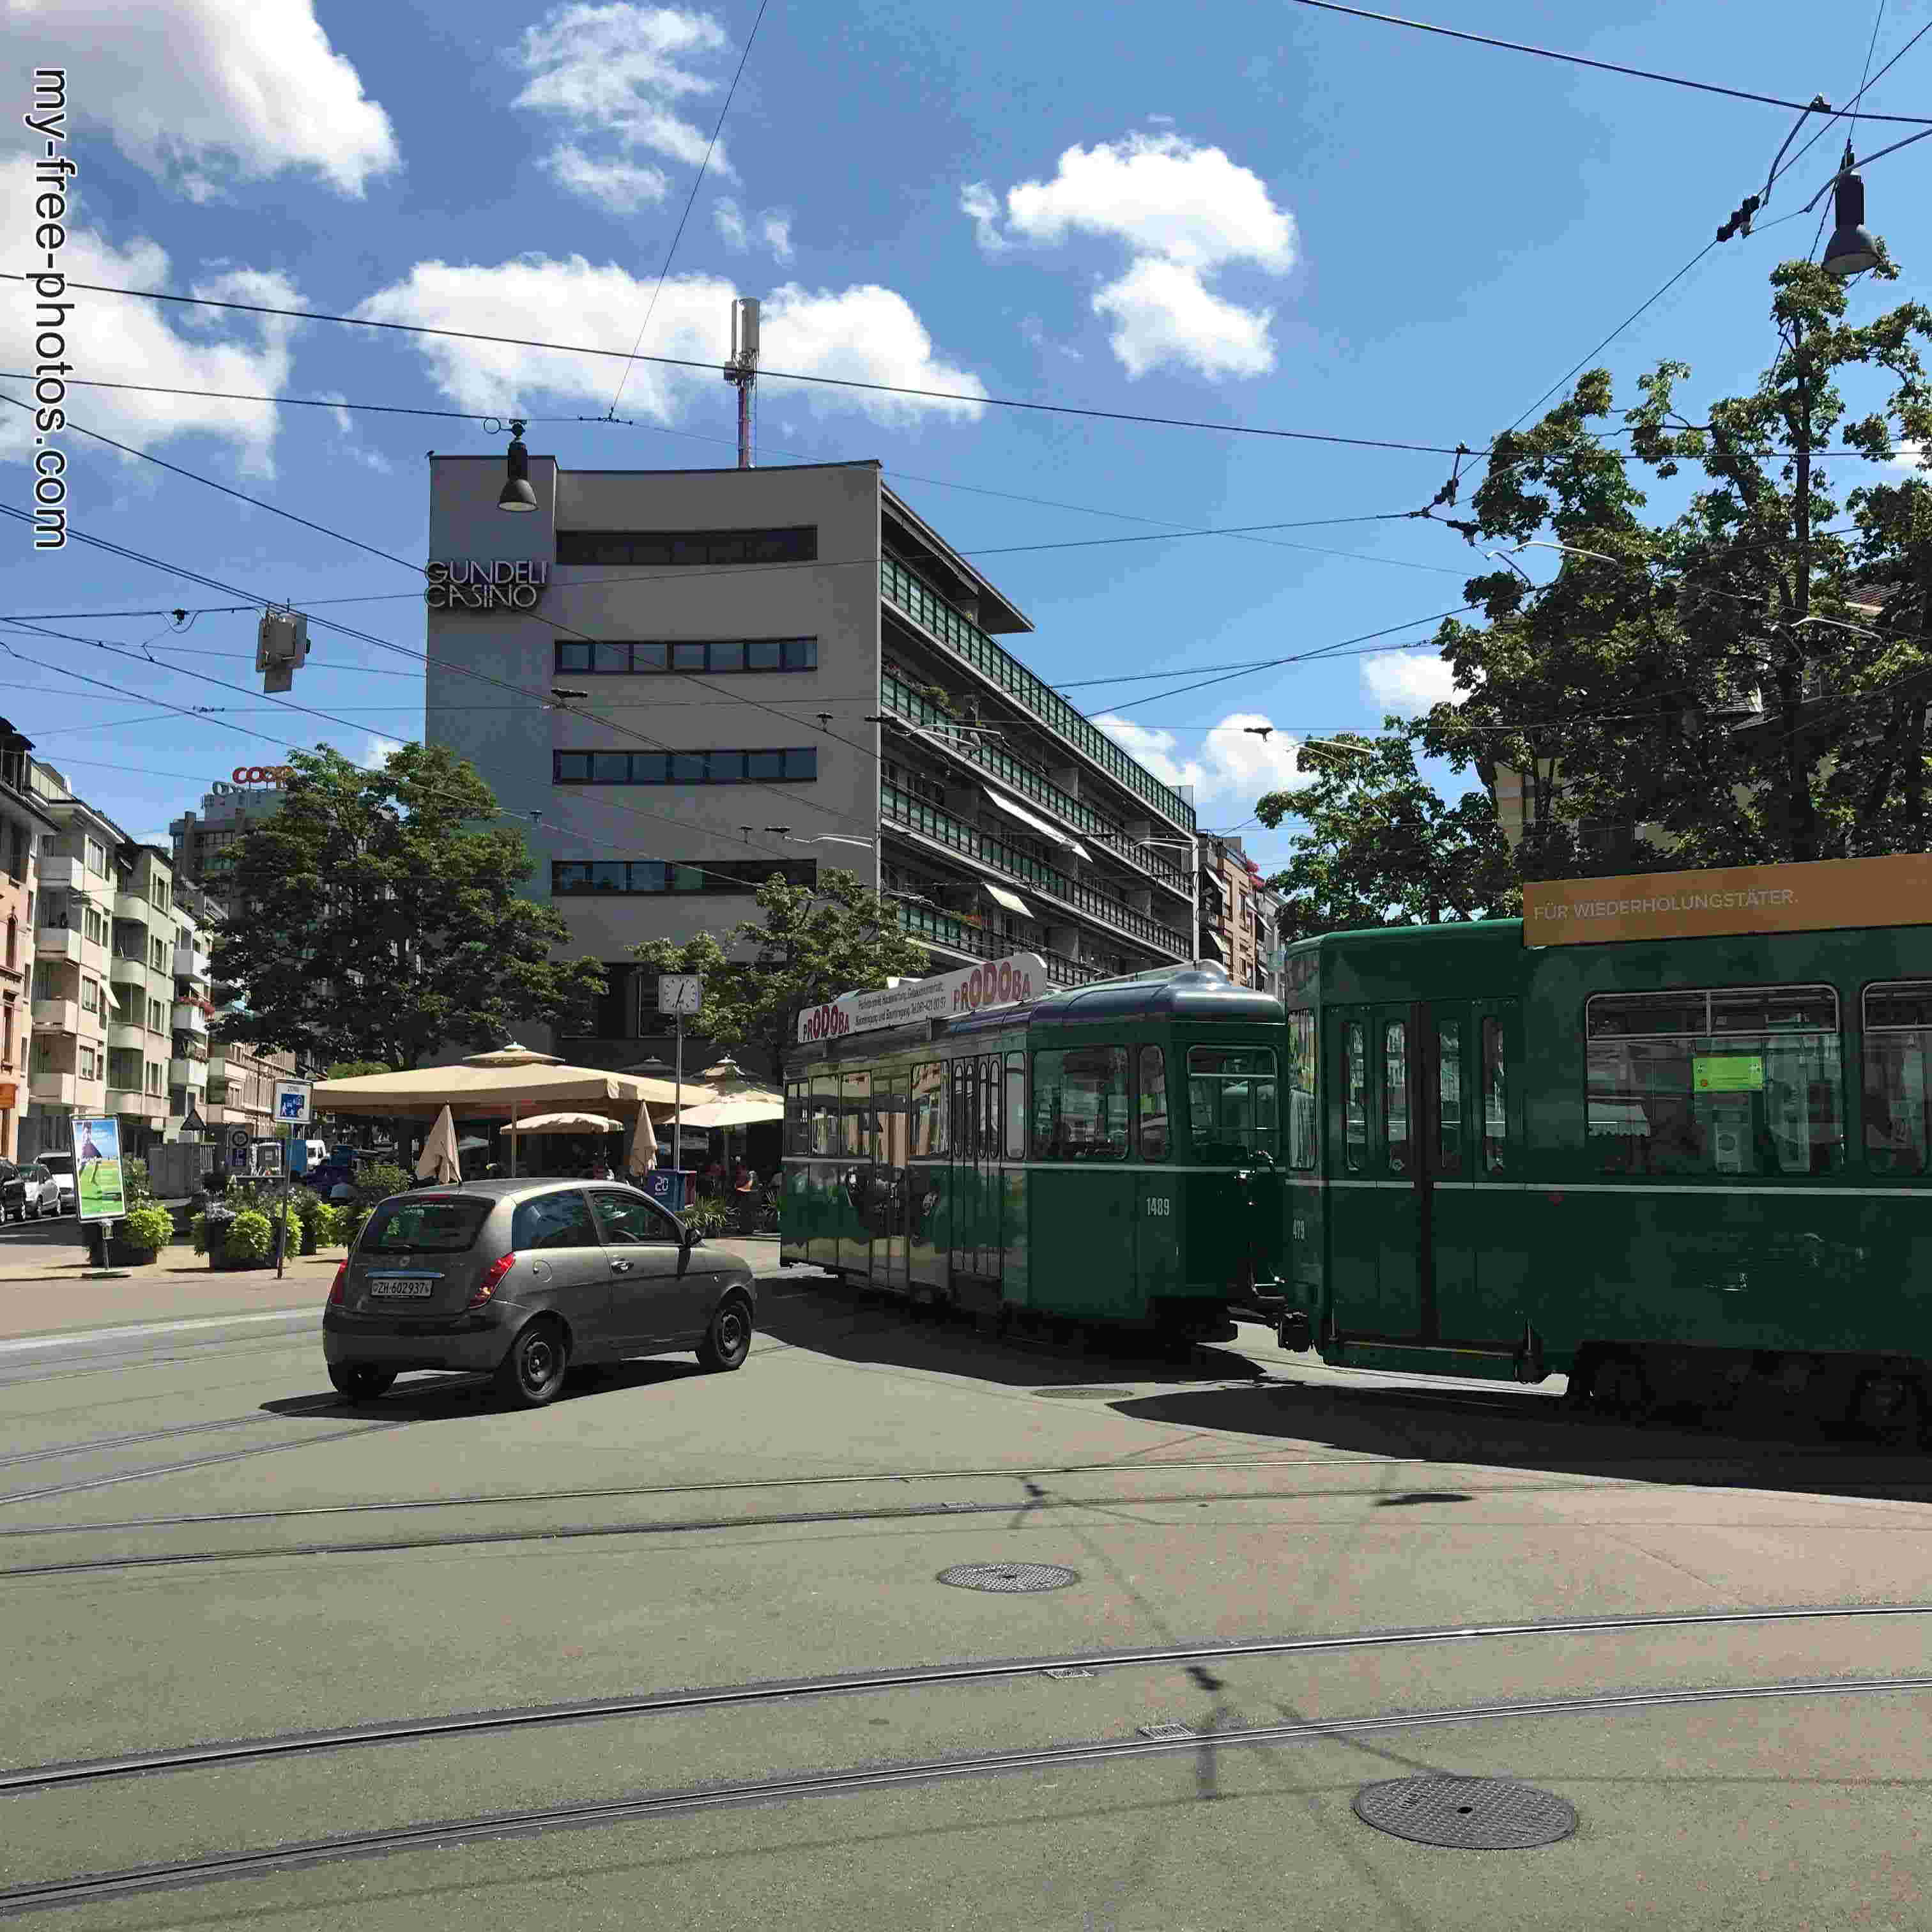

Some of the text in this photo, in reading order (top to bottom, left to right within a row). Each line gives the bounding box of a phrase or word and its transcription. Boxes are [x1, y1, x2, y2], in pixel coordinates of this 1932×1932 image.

[425, 560, 548, 584] GUNDELI
[424, 583, 537, 608] CASINO
[1533, 889, 1798, 920] FÜR WIEDERHOLUNGSTÄTER.
[952, 961, 1032, 1012] PRODOBA
[802, 1005, 850, 1041] PRODOBA
[655, 1176, 669, 1192] 20
[1146, 1197, 1170, 1216] 1489
